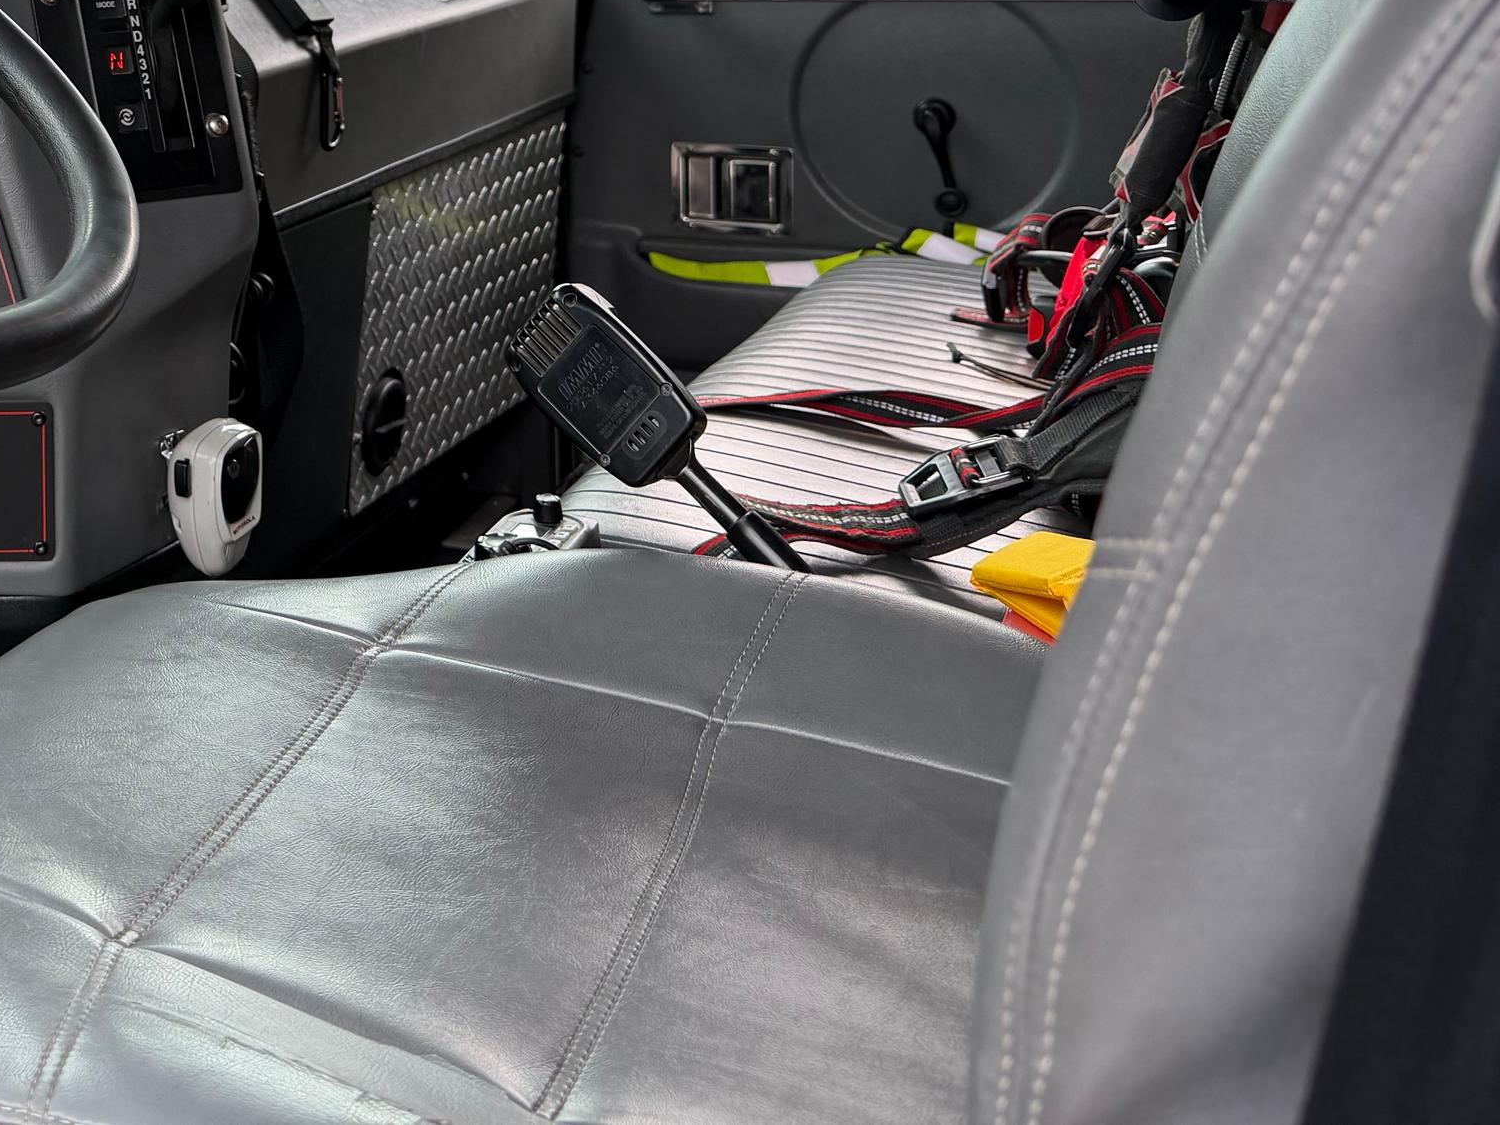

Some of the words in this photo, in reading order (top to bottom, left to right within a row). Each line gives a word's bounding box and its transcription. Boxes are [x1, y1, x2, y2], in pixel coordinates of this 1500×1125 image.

[96, 1, 116, 9] MODE
[130, 15, 140, 27] N
[132, 31, 143, 43] D
[136, 44, 145, 57] 4
[109, 52, 124, 70] N
[139, 59, 147, 71] 3
[142, 73, 150, 84] 2
[144, 88, 152, 100] 1
